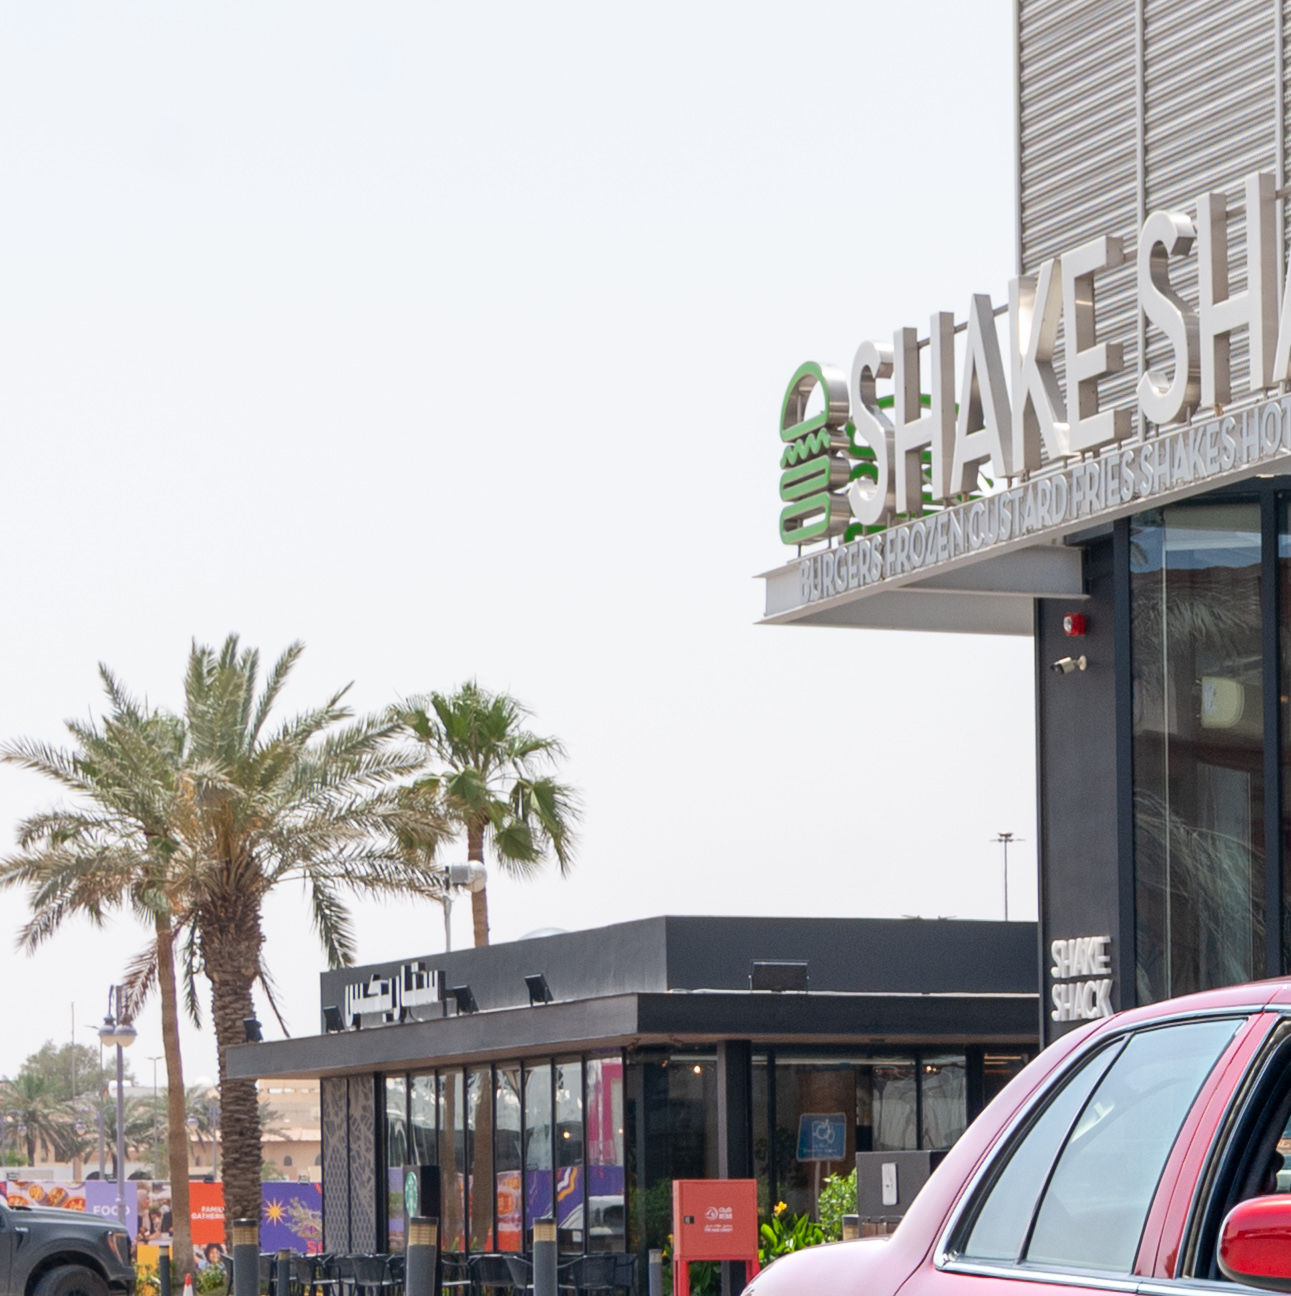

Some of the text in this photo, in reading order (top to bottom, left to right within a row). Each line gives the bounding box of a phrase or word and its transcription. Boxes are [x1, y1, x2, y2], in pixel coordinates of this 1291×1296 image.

[848, 235, 1126, 526] SHAKE
[799, 535, 883, 602] BURGERS
[884, 511, 966, 577] FROZEN
[968, 473, 1068, 547] CUSTARD
[1071, 449, 1135, 518] FRIES
[1140, 416, 1237, 497] SHAKES
[1051, 936, 1112, 978] SHAKE
[1051, 979, 1114, 1022] SHACK
